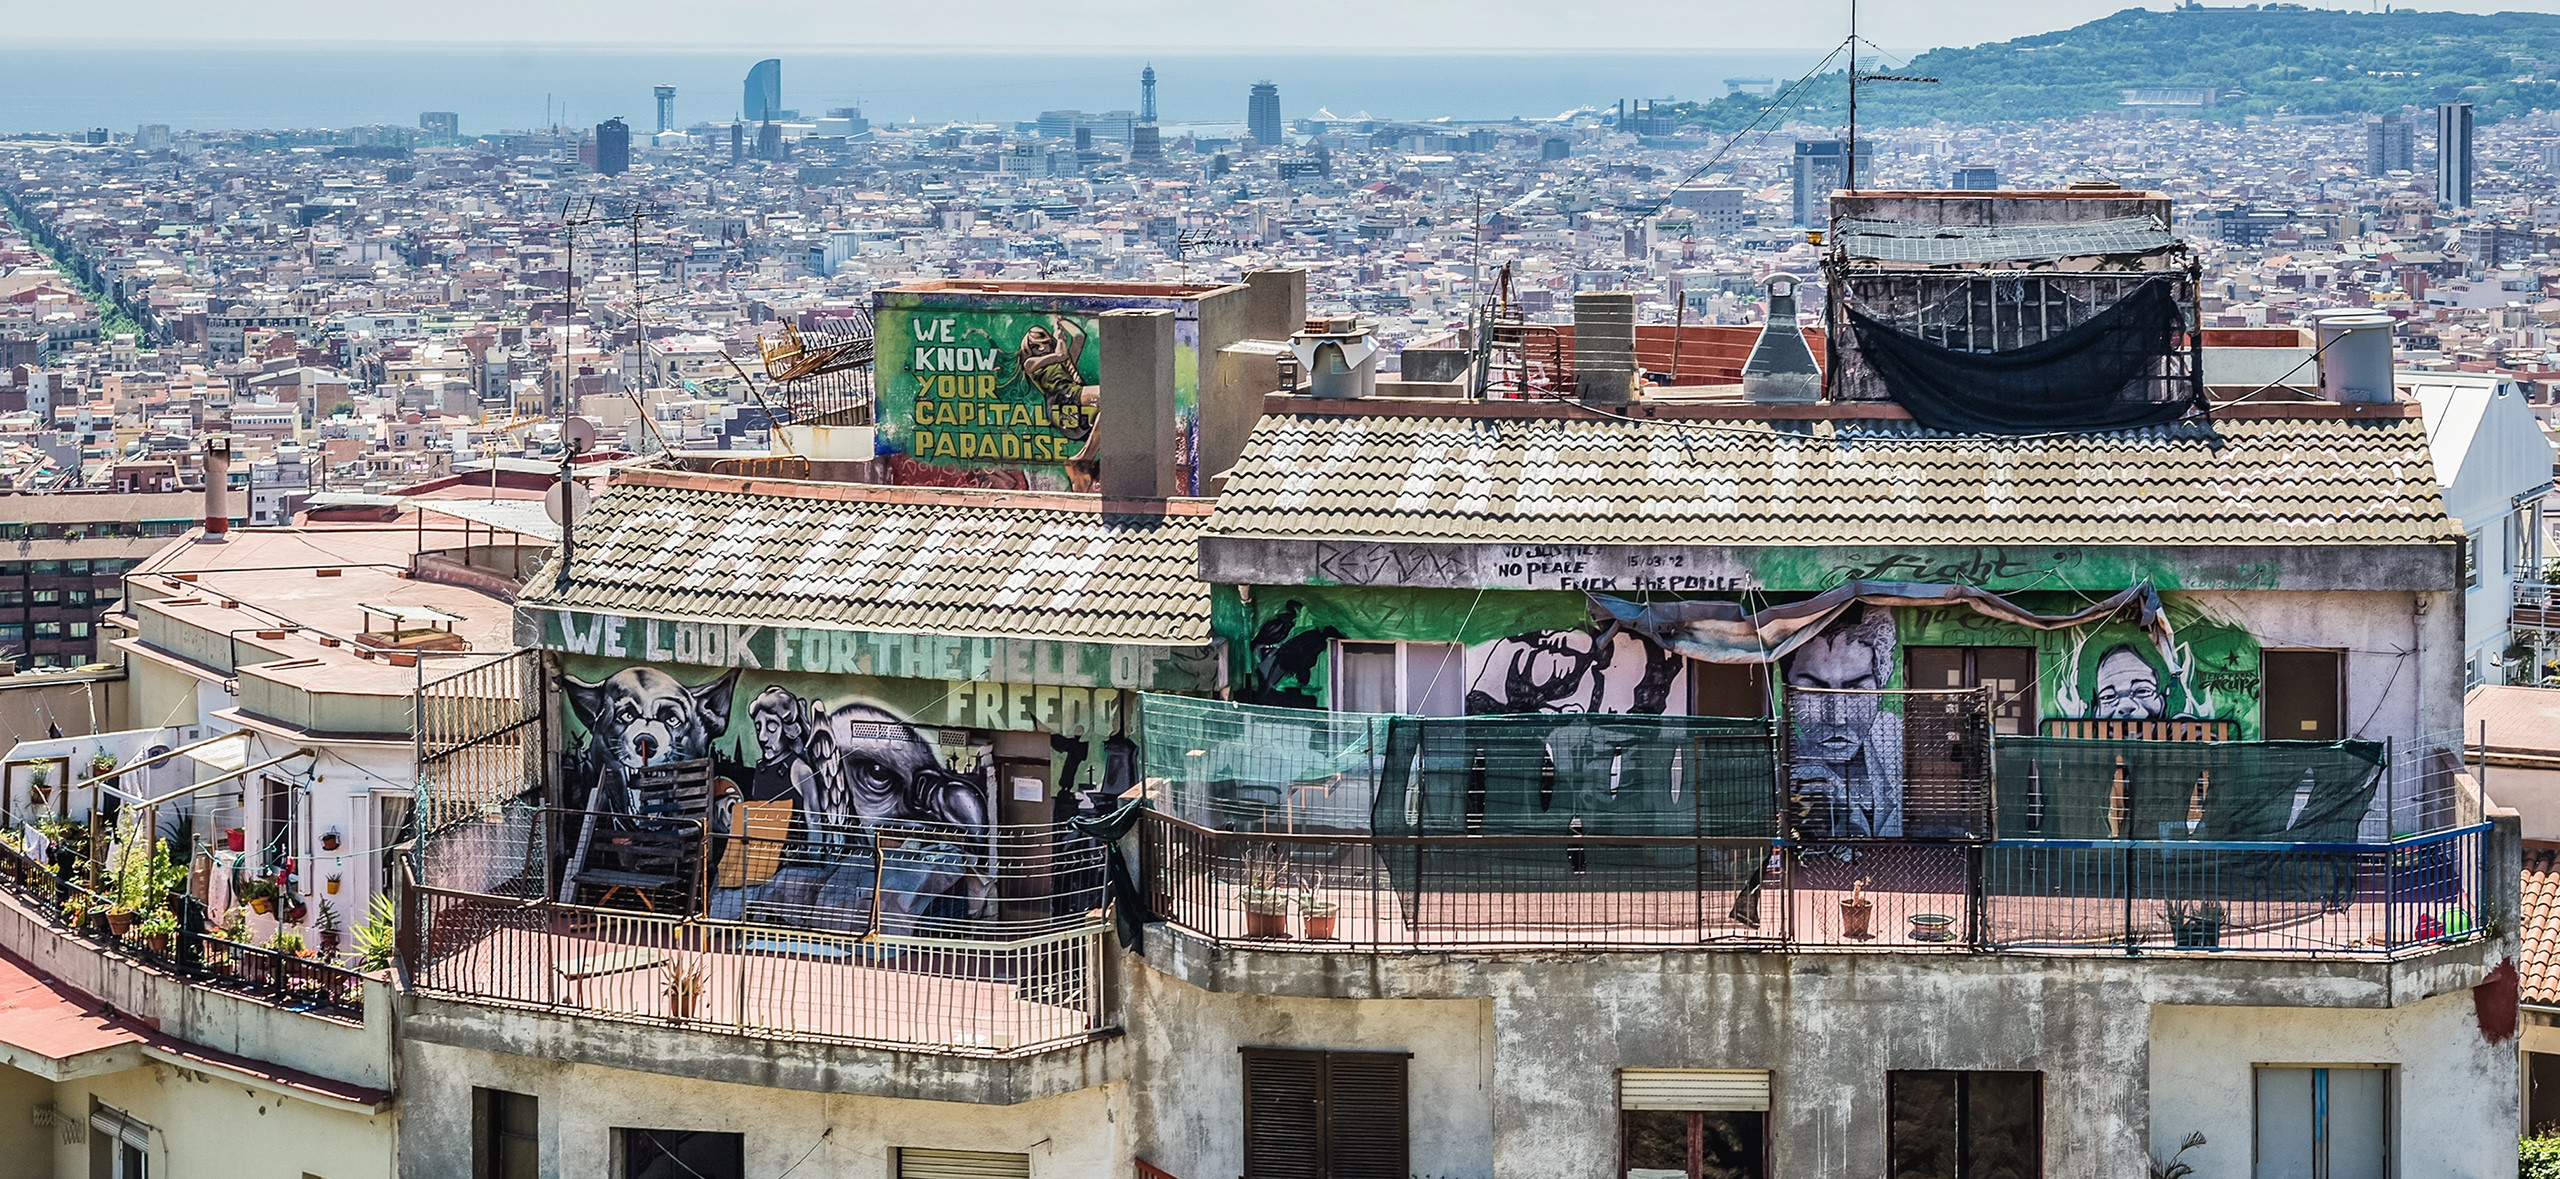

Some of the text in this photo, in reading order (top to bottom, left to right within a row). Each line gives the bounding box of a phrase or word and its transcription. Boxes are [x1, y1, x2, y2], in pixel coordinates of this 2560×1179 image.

[913, 319, 955, 343] WE
[915, 348, 998, 372] KNOW
[916, 374, 998, 399] YOUR
[915, 430, 1069, 460] PARADiSE
[1498, 563, 1523, 578] NO
[646, 619, 762, 670] LOOK
[774, 627, 860, 675] FOR
[866, 633, 970, 682] THE
[971, 637, 1092, 687] HELL
[1110, 643, 1172, 691] OF
[948, 681, 1139, 736] FREEDO
